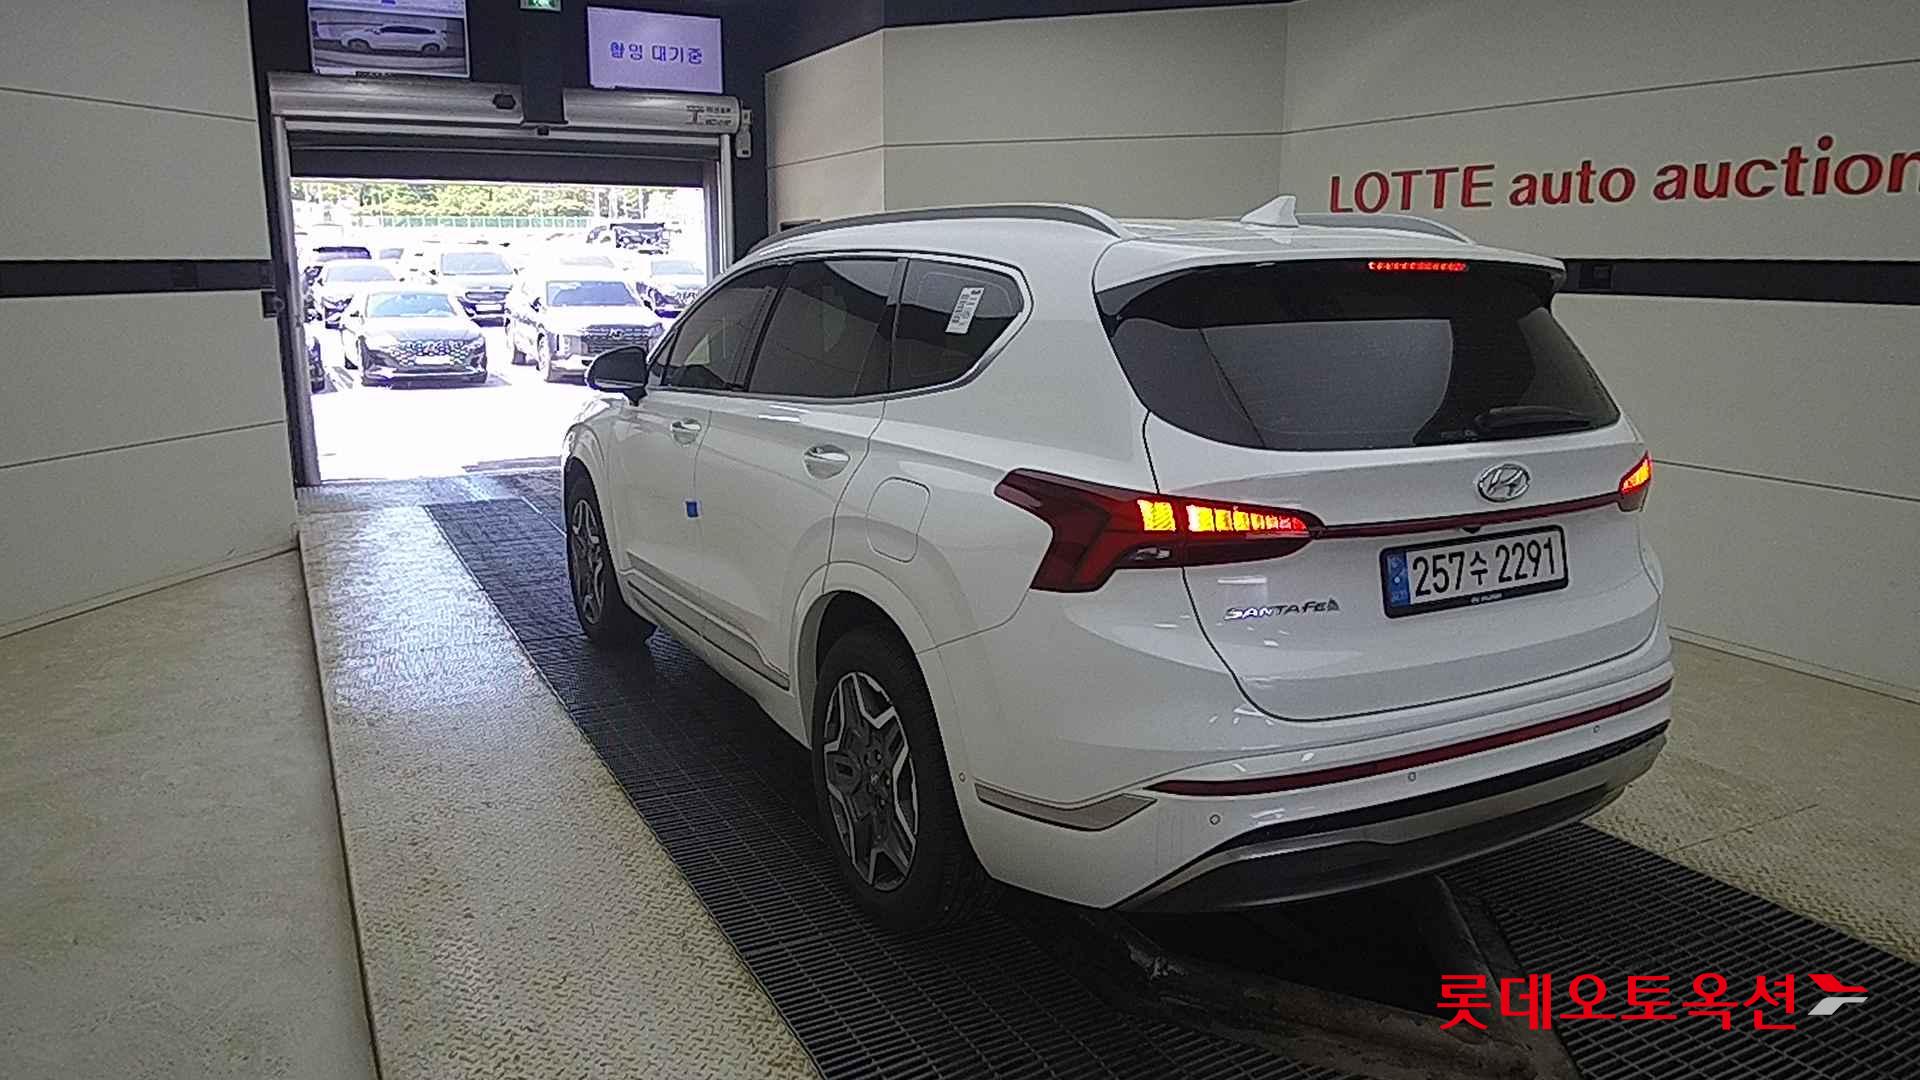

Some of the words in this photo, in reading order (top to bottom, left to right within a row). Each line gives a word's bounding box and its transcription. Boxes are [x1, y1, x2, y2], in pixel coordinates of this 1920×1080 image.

[651, 44, 703, 65] 대기중
[1329, 163, 1496, 214] LOTTE
[1508, 159, 1638, 208] auto
[1412, 550, 1489, 598] 257수
[1494, 536, 1556, 584] 2291
